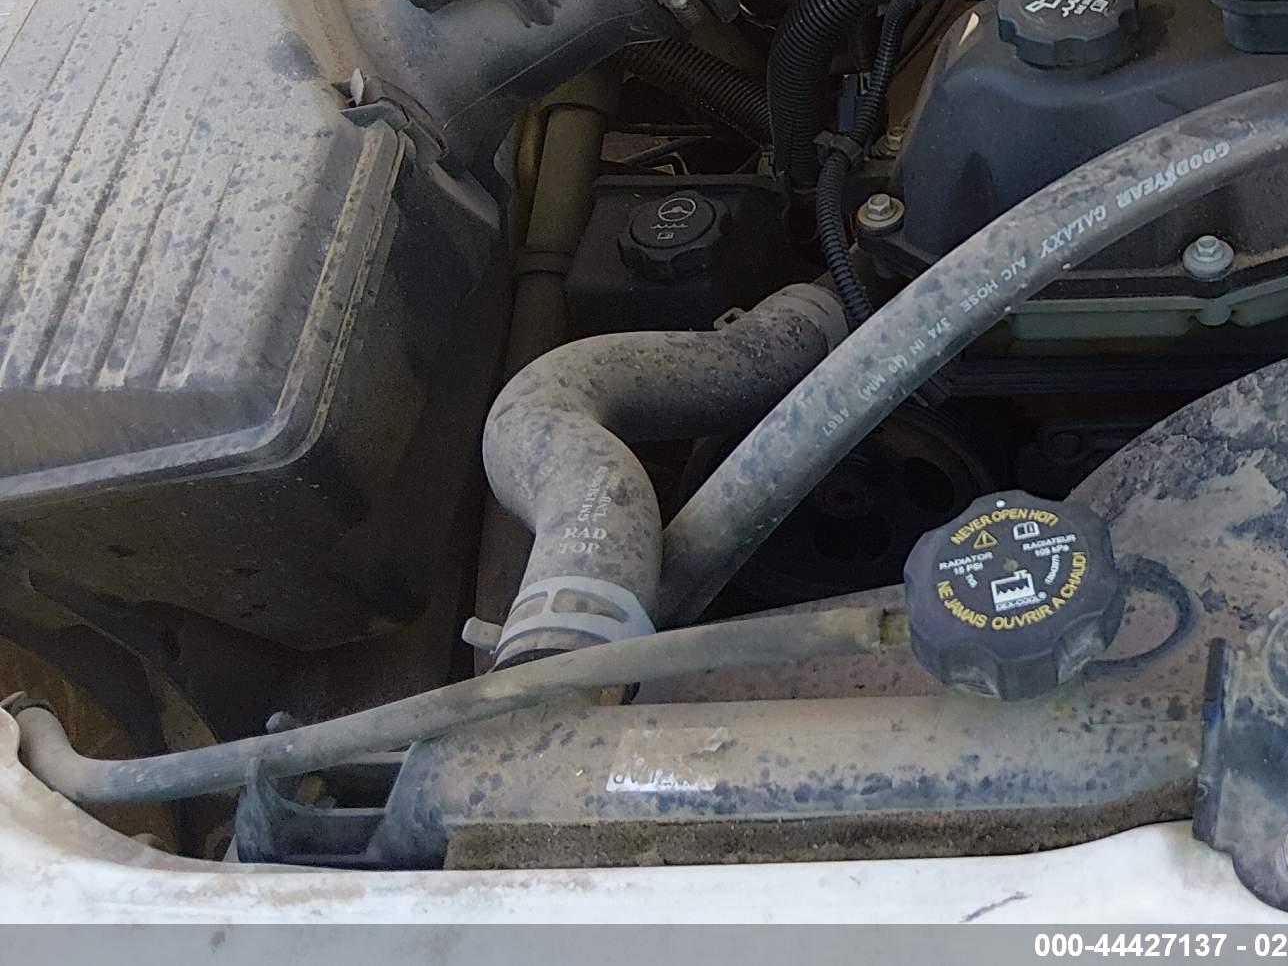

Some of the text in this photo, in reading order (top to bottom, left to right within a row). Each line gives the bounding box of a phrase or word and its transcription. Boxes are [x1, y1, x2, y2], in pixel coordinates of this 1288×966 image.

[1115, 141, 1231, 209] GOODYEAR
[1038, 208, 1108, 260] GALAXY
[1000, 257, 1027, 283] A/C
[960, 281, 1000, 315] HOSE
[563, 527, 608, 540] RAD
[951, 515, 993, 545] NEVER
[991, 508, 1029, 523] OPEN
[559, 542, 600, 554] TOP
[1022, 534, 1077, 552] RADIATEUR
[939, 551, 993, 571] RADIATOR
[965, 562, 984, 574] PSI
[1060, 552, 1087, 599] CHAUD!
[936, 580, 954, 600] NE
[944, 598, 989, 629] JAMAIS
[991, 605, 1055, 631] OUVRIR
